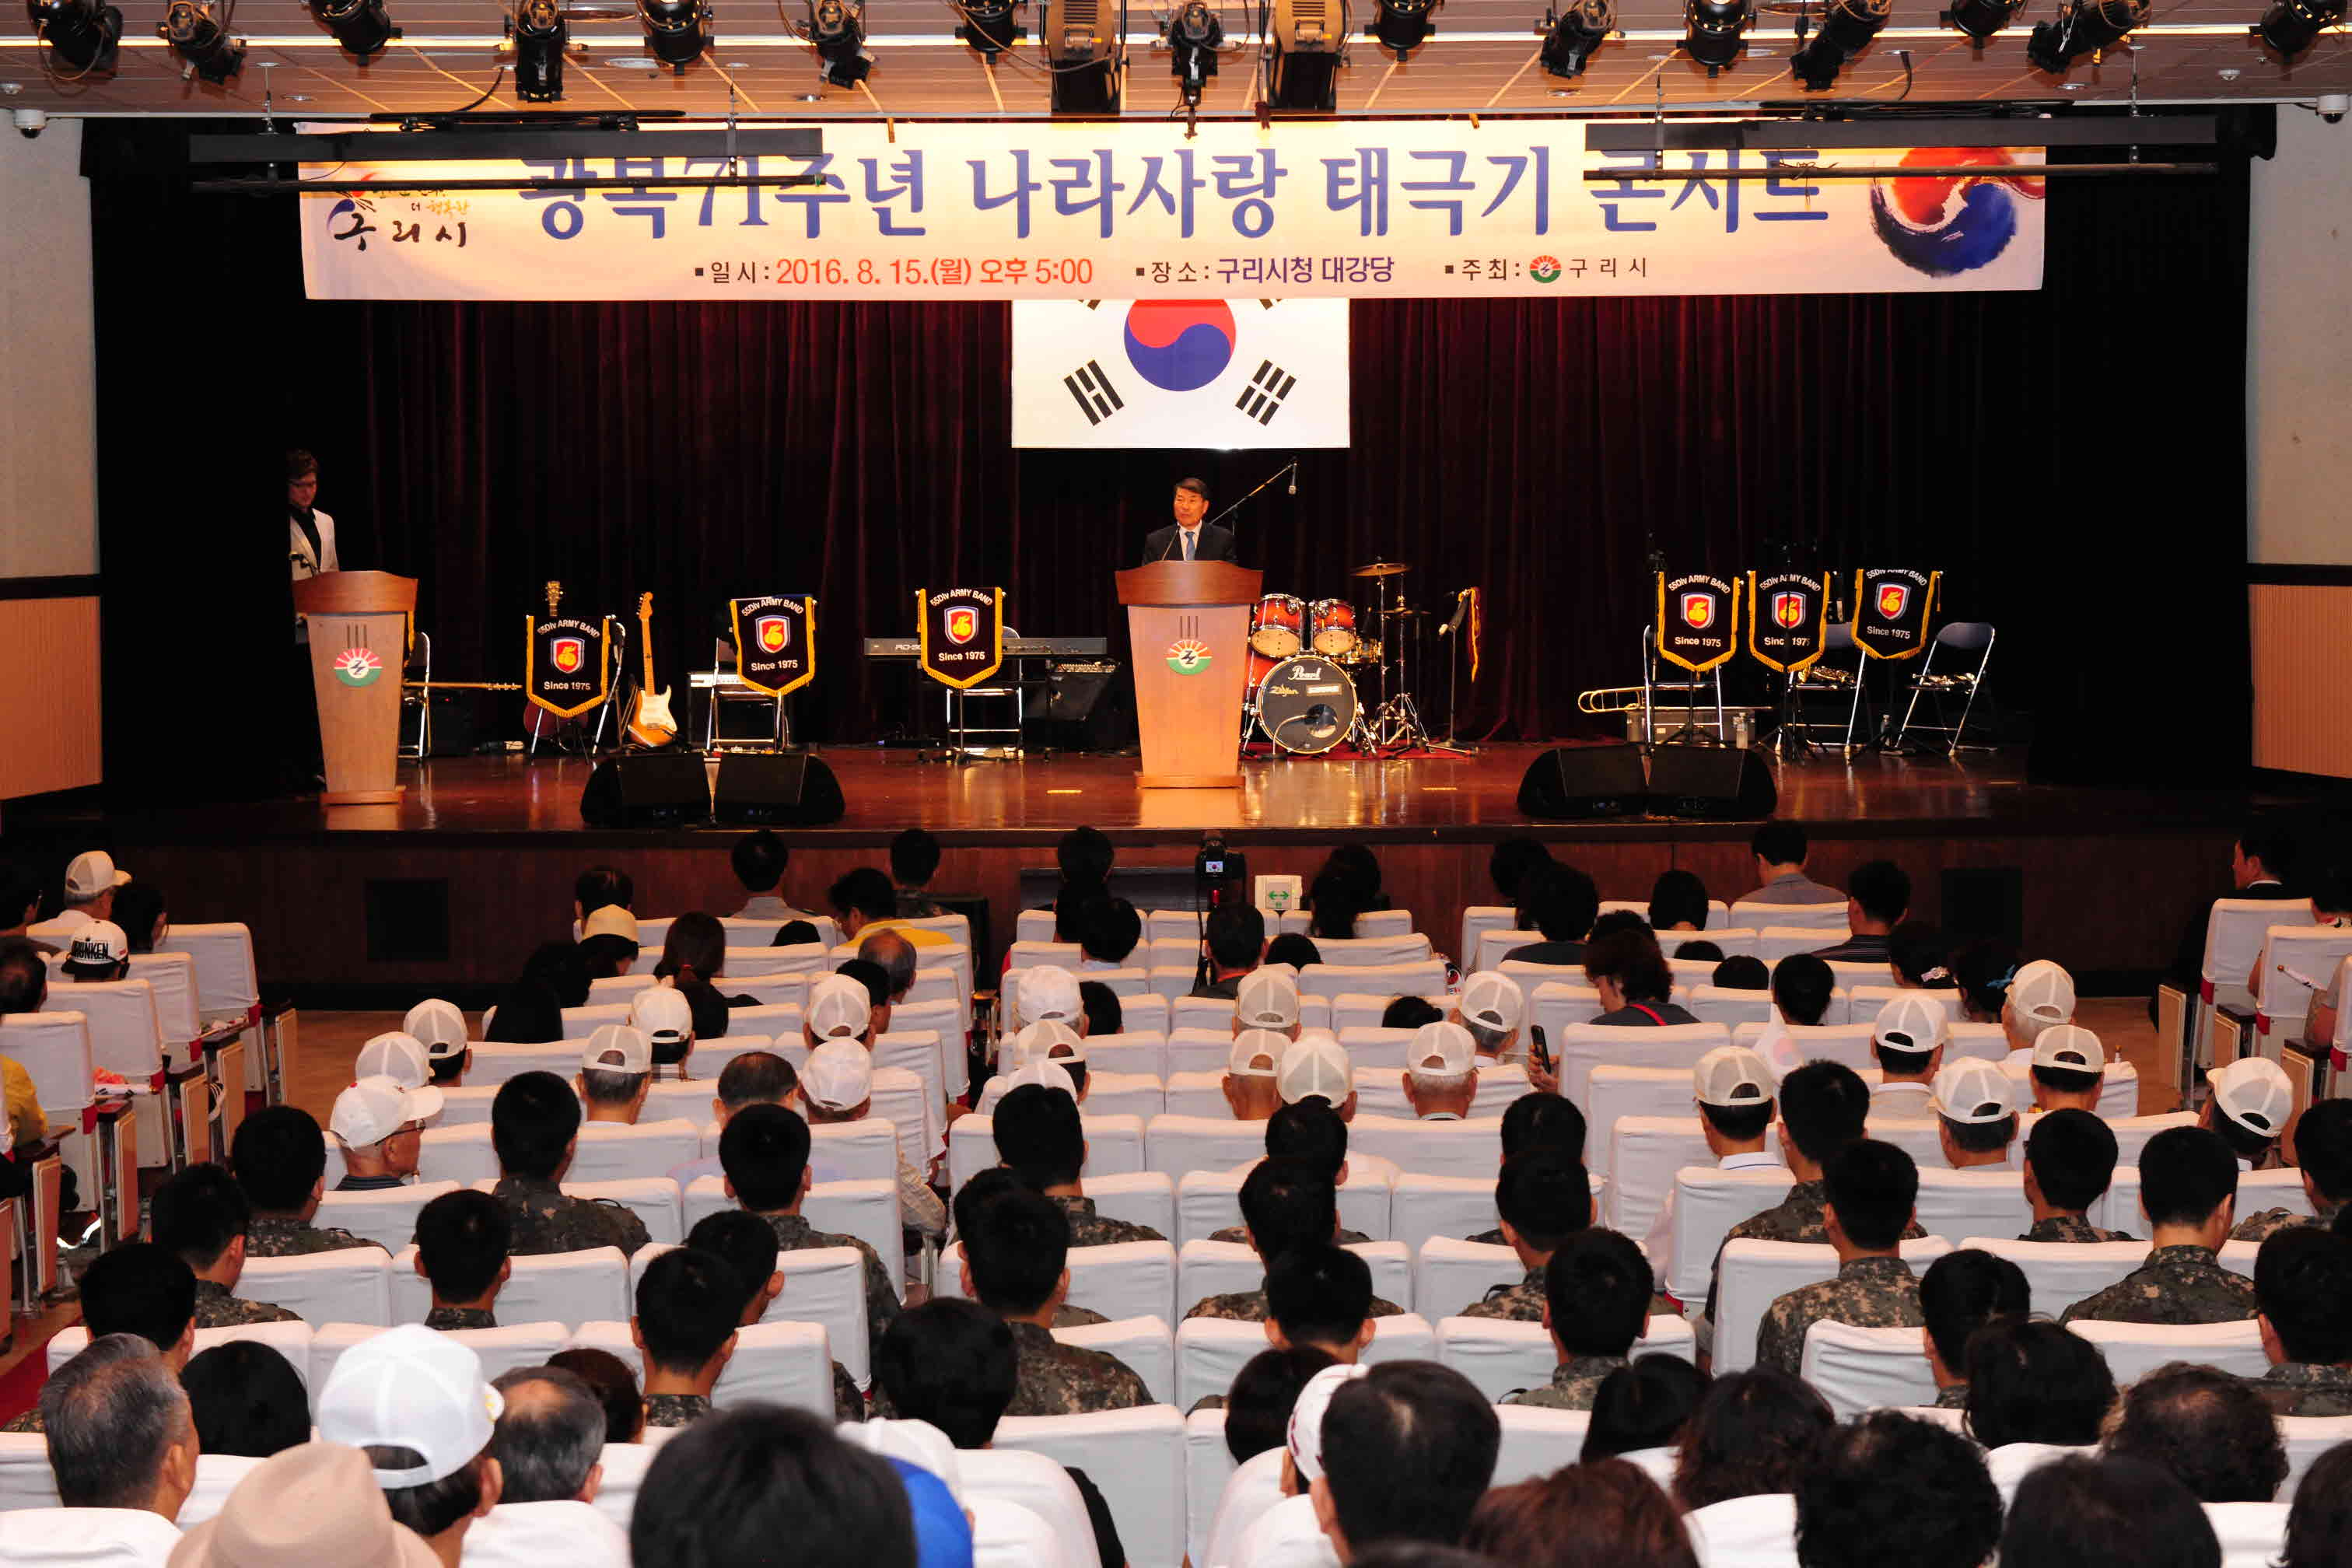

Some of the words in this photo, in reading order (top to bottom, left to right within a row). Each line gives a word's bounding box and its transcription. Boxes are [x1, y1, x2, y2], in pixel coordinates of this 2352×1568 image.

[966, 149, 1288, 238] 나라사랑
[1320, 146, 1549, 236] 태극기
[778, 258, 849, 285] 2016.
[979, 257, 1028, 285] 오후
[1035, 258, 1093, 284] 5:00
[1216, 257, 1313, 283] 구리시청
[1322, 256, 1393, 282] 대강당
[1710, 577, 1730, 593] BAND
[1801, 576, 1822, 591] BAND
[1909, 571, 1927, 586] BAND
[972, 590, 992, 605] BAND
[783, 600, 804, 614] BAND
[580, 622, 600, 638] BAND
[1867, 625, 1889, 635] Since
[1892, 628, 1910, 639] 1975
[1675, 636, 1699, 646] Since
[1702, 638, 1721, 647] 1975
[1764, 637, 1785, 646] Sinc
[938, 652, 963, 661] Since
[965, 652, 985, 661] 1975
[751, 663, 775, 671] Since
[777, 660, 798, 669] 1975
[1288, 665, 1322, 681] Pearl
[544, 681, 569, 690] Since
[571, 681, 591, 690] 1975
